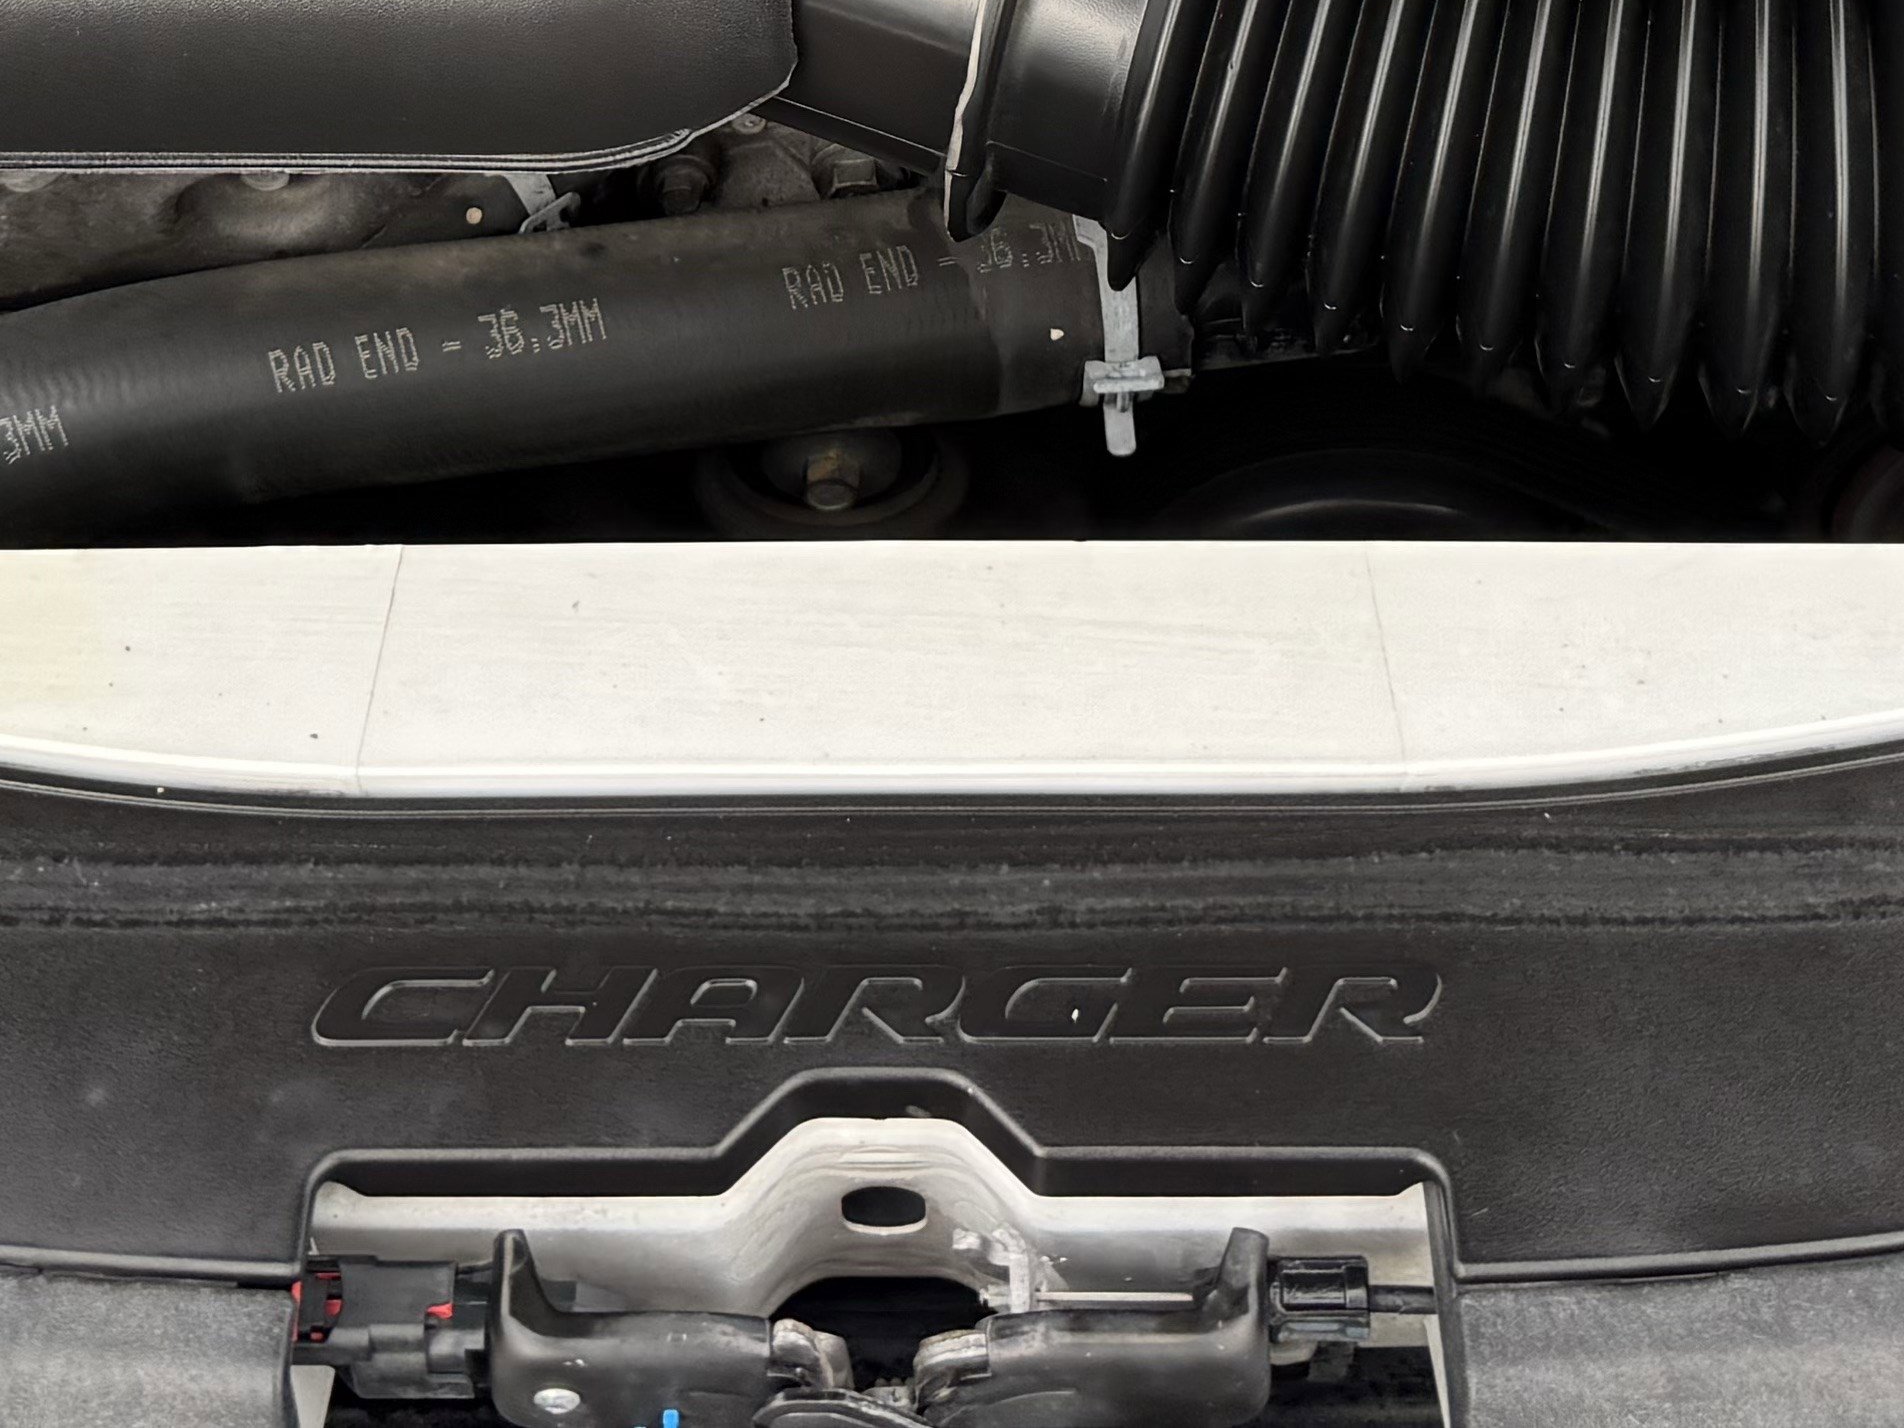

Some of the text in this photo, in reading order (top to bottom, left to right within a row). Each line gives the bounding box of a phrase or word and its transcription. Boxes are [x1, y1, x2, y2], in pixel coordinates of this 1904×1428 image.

[782, 262, 844, 310] RAD
[859, 245, 919, 295] END
[267, 341, 336, 394] RAD
[353, 326, 419, 380] END
[309, 963, 1445, 1049] CHARGER
